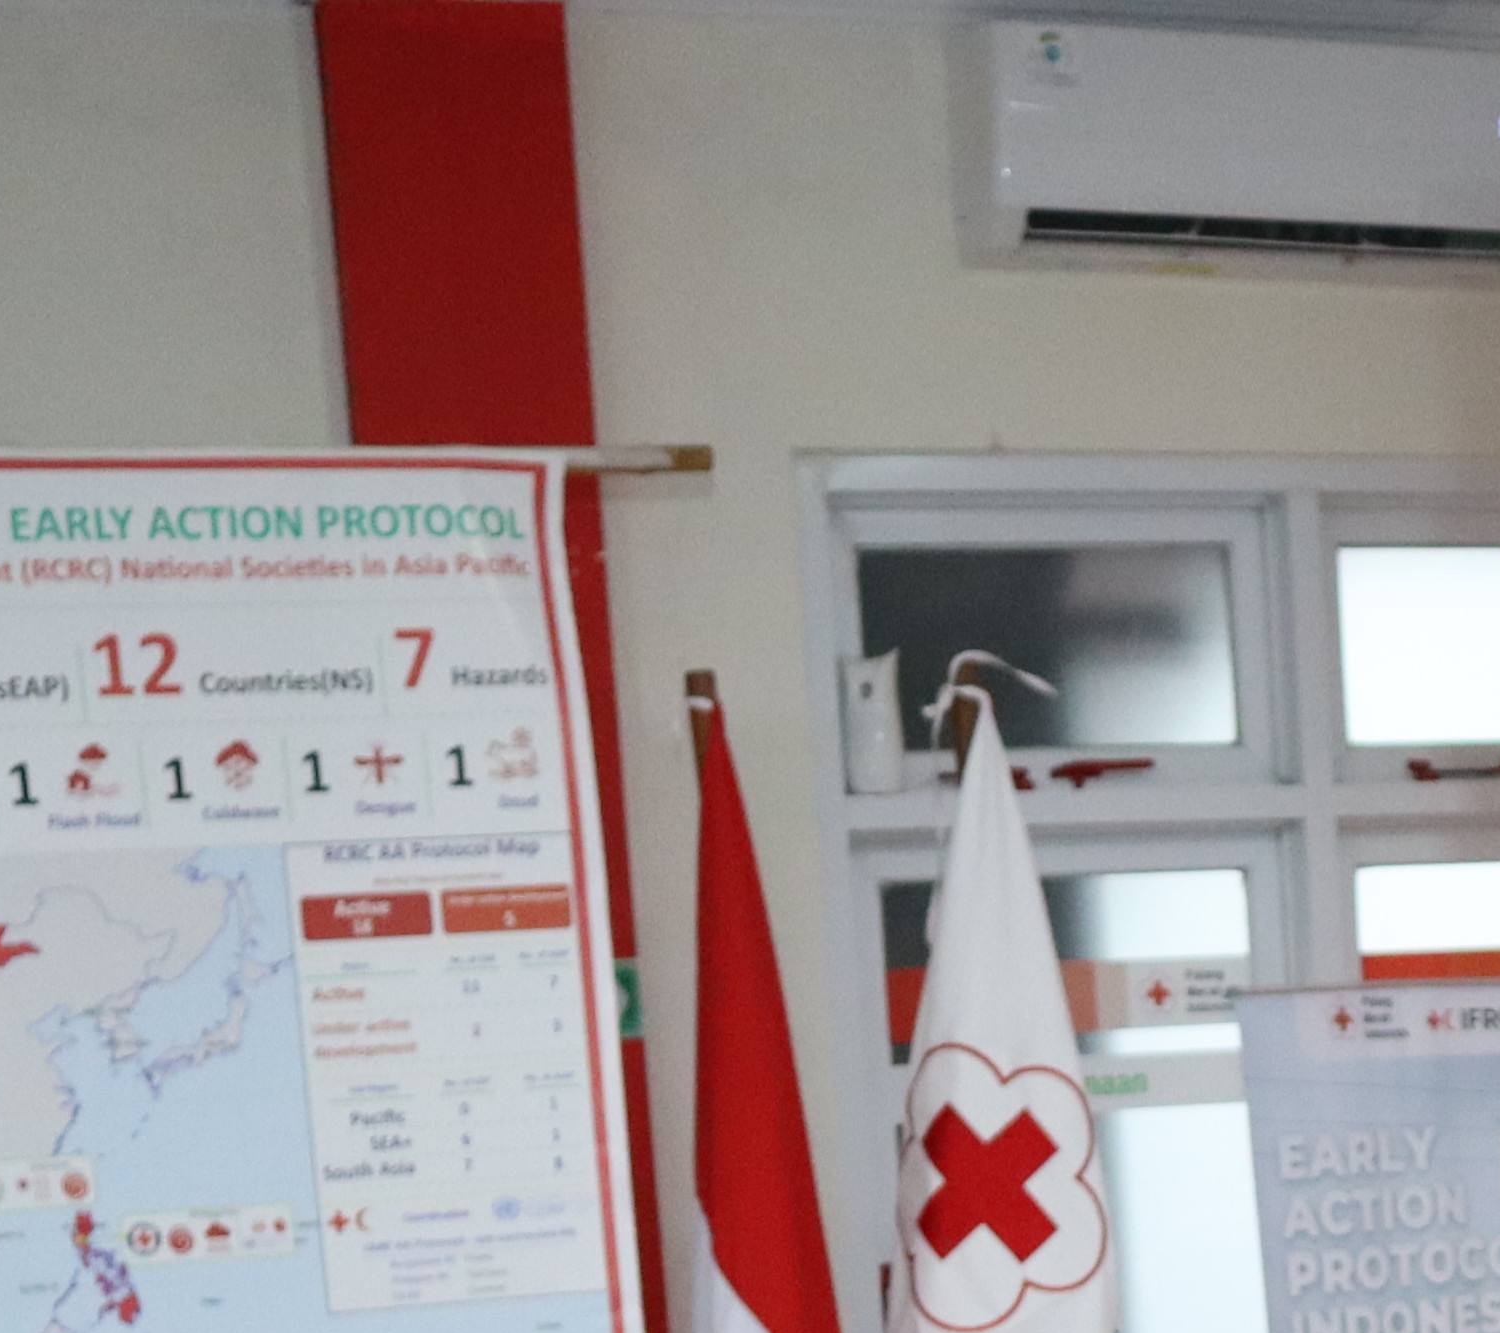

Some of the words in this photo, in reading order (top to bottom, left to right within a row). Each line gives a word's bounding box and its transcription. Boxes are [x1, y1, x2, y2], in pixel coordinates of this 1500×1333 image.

[10, 505, 134, 543] EARLY
[147, 504, 304, 541] ACTION
[317, 503, 527, 540] PROTOCOL
[20, 553, 113, 586] (RCRC)
[121, 554, 231, 582] National
[239, 552, 353, 580] Societies
[362, 552, 387, 578] in
[394, 551, 450, 577] Asia
[94, 631, 184, 698] 12
[199, 665, 375, 698] Countries(NS)
[394, 626, 435, 689] 7
[450, 662, 550, 688] Hazards
[8, 761, 40, 806] 1
[163, 757, 194, 801] 1
[302, 749, 331, 793] 1
[446, 744, 475, 788] 1
[1279, 1124, 1437, 1182] EARLY
[1283, 1181, 1469, 1241] ACTION
